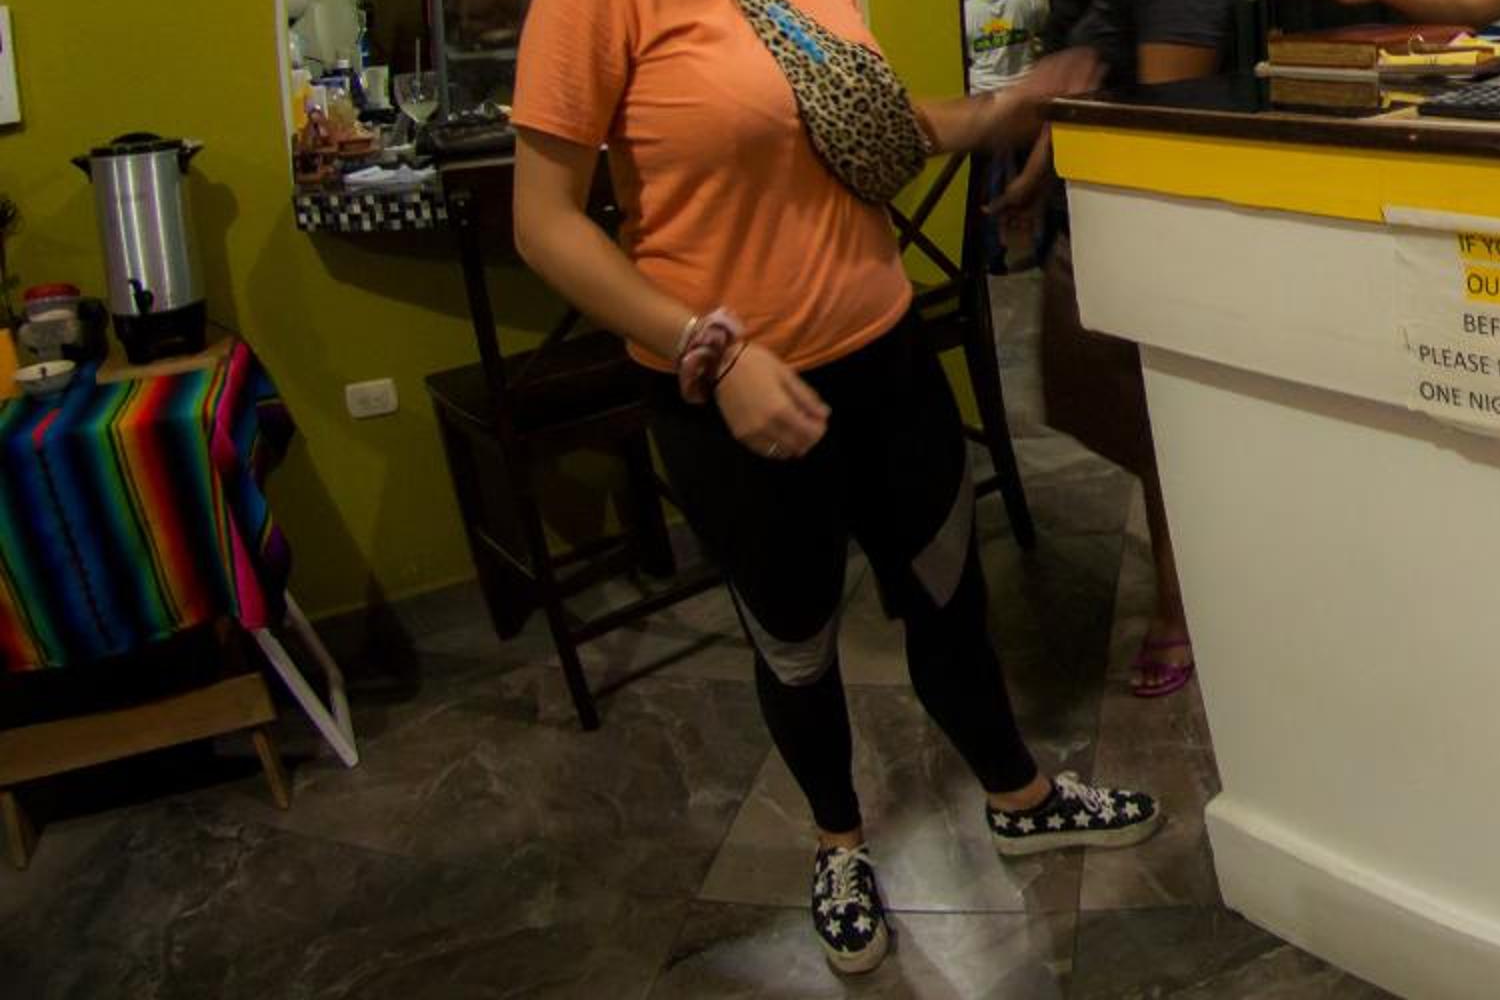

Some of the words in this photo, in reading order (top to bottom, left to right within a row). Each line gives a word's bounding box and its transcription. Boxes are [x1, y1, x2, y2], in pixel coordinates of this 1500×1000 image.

[1458, 233, 1475, 252] IF
[1419, 345, 1490, 376] PLEASE
[1419, 381, 1462, 407] ONE
